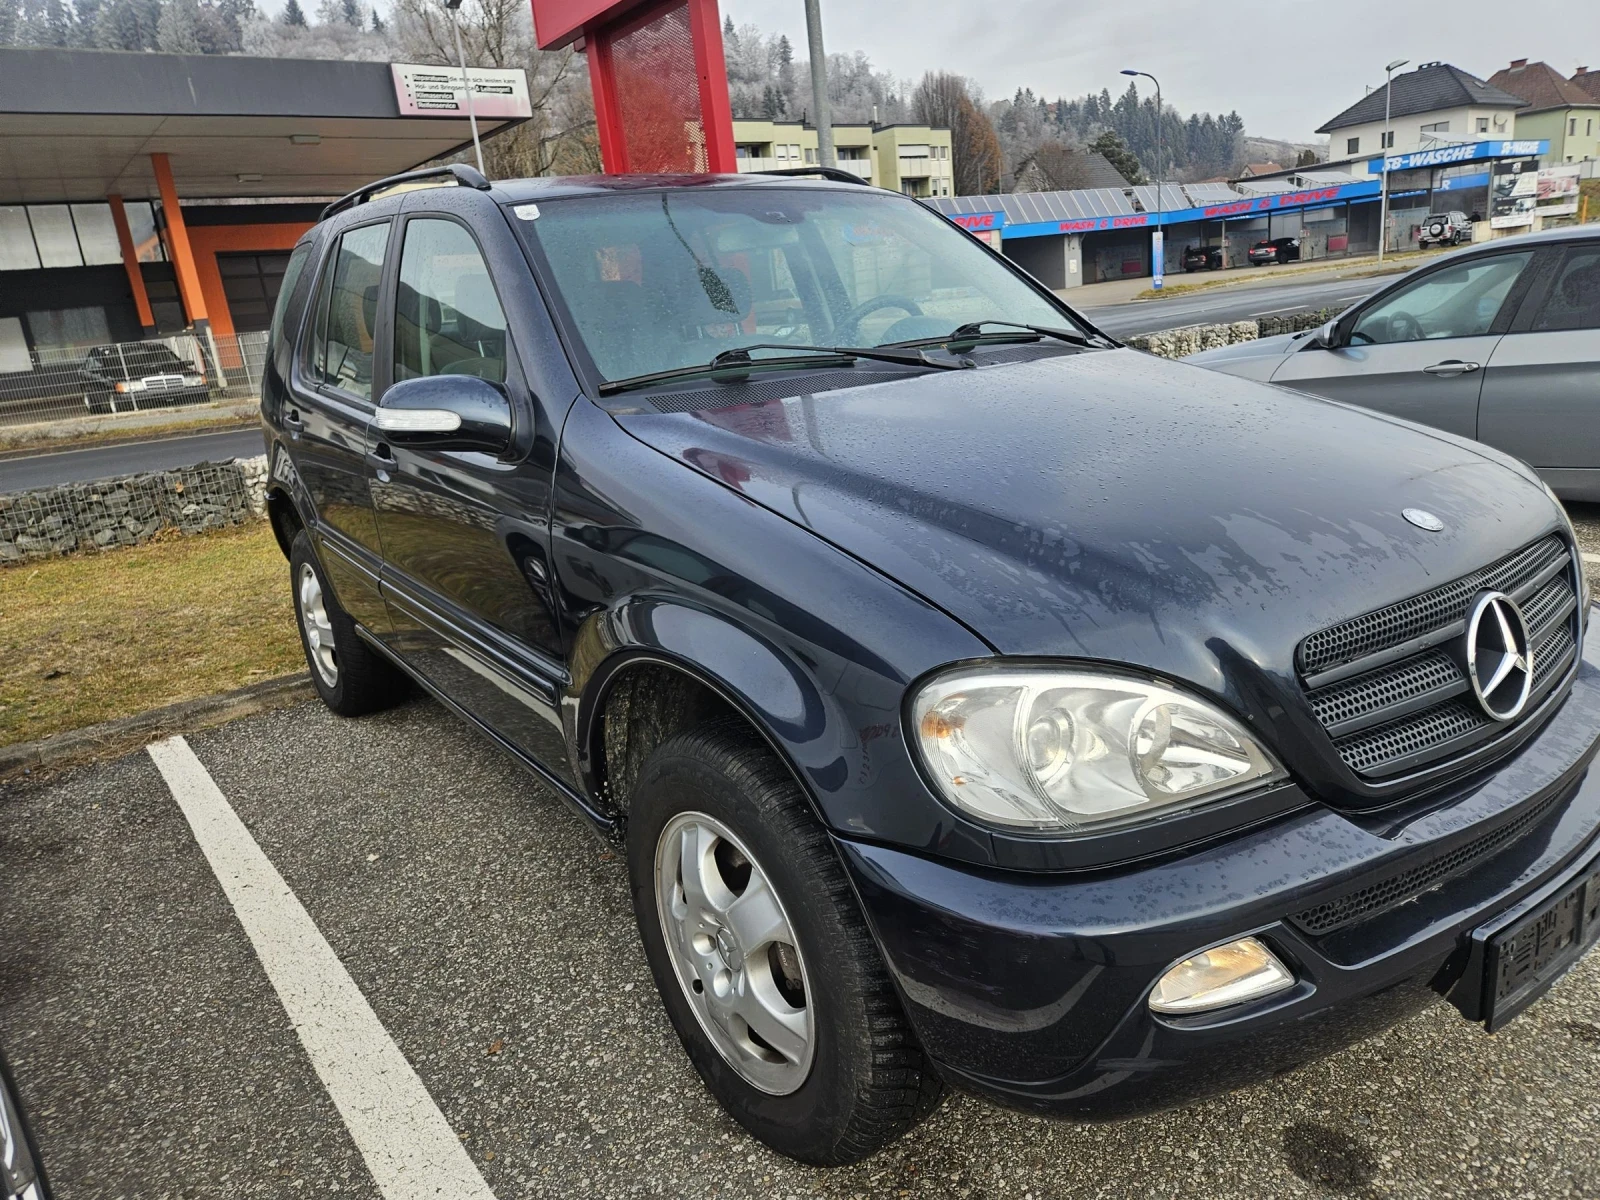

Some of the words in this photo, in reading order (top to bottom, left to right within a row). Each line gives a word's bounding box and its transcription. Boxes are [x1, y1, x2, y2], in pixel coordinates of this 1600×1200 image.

[1204, 201, 1252, 217] WASH
[1258, 198, 1272, 209] &
[1279, 187, 1341, 206] DRIVE
[1059, 218, 1096, 231] WASH
[1099, 217, 1109, 229] &
[1112, 215, 1149, 227] DRIVE
